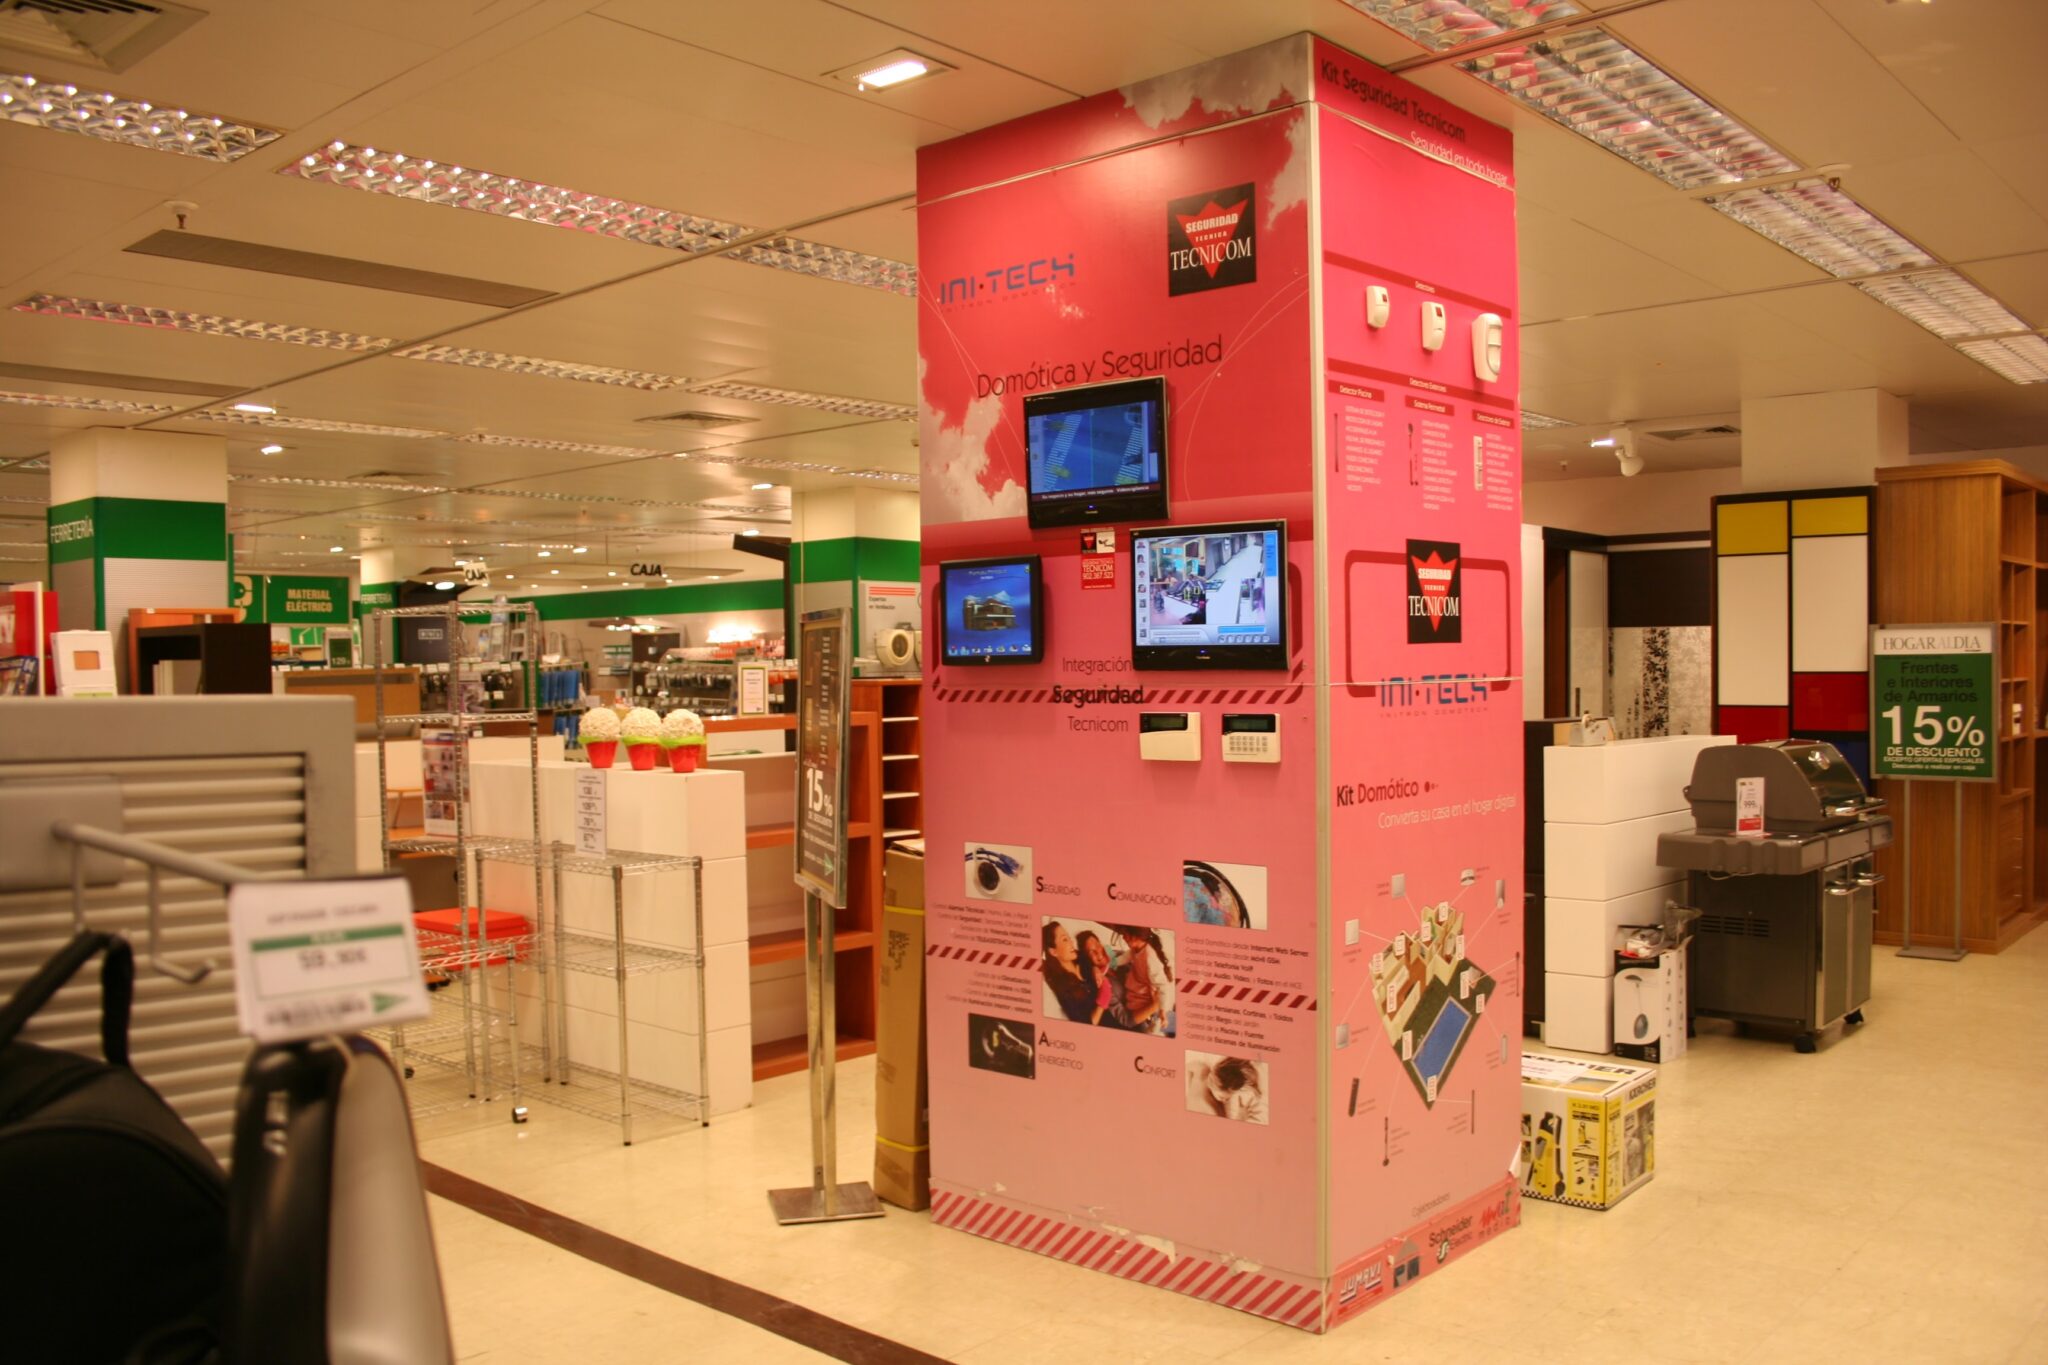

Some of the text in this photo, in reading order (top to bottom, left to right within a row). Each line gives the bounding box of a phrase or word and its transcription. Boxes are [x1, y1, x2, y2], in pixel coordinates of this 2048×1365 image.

[1321, 58, 1466, 143] Kit Seguridad Tecnicom
[1184, 212, 1239, 234] SEGURIDAD
[1194, 230, 1228, 243] TECNICA
[1169, 236, 1253, 271] TECNICOM
[977, 334, 1223, 399] Domótica y Seguridad
[49, 515, 94, 545] FERRETERÍA
[464, 567, 487, 582] CAJA
[630, 563, 662, 577] CAJA
[1417, 567, 1453, 581] SEGURIDAD
[286, 588, 331, 601] MATERIAL
[1408, 595, 1460, 617] TECNICOM
[1061, 656, 1133, 676] Integración
[1900, 661, 1959, 674] Frentes
[1886, 676, 1974, 689] e Interiores
[1051, 683, 1146, 709] Seguridad
[1883, 690, 1978, 703] de Armarios
[1067, 715, 1129, 732] Tecnicom
[1881, 705, 1986, 747] 15%
[1886, 746, 1981, 758] DE DESCUENTO
[1336, 777, 1420, 808] Kit Domótico
[1035, 875, 1081, 896] SEGURIDAD
[1038, 1030, 1077, 1052] AHORRO
[1134, 1055, 1177, 1079] CONFORT
[1428, 1215, 1473, 1248] Schneider
